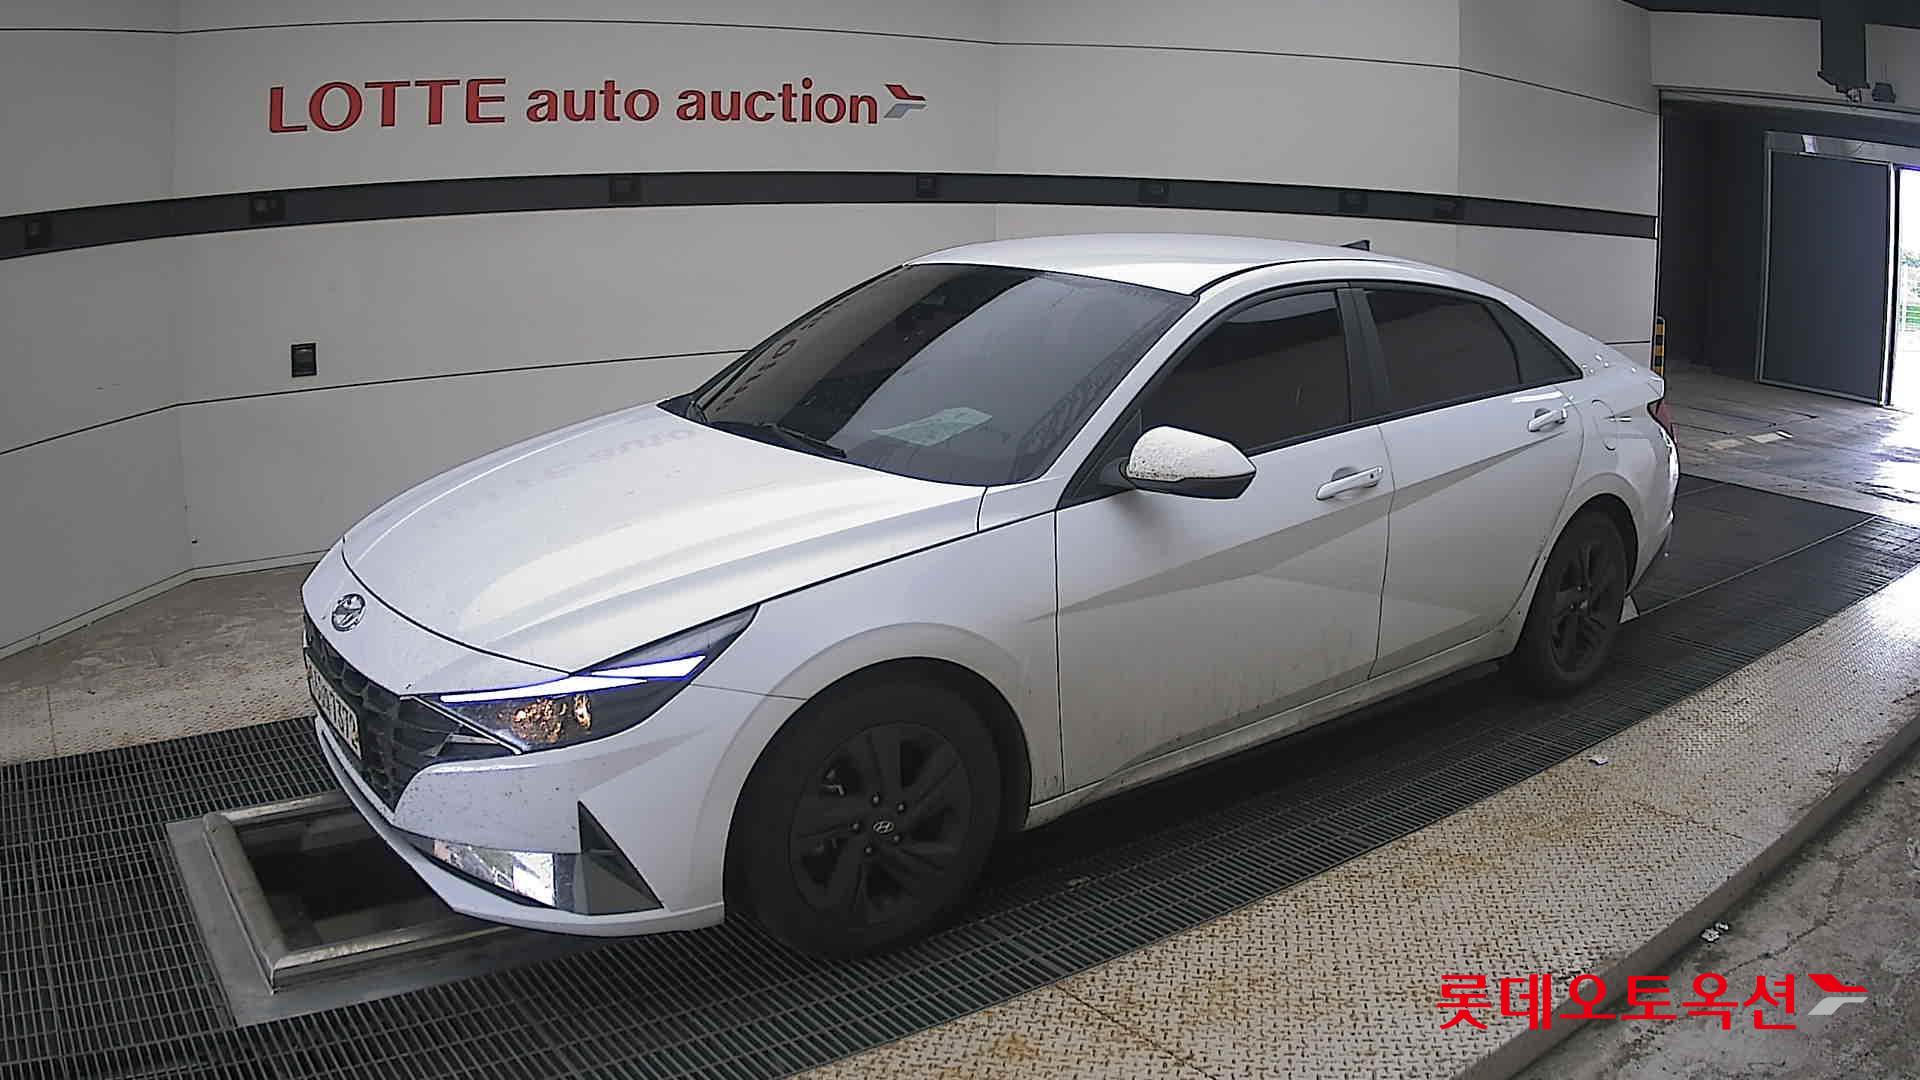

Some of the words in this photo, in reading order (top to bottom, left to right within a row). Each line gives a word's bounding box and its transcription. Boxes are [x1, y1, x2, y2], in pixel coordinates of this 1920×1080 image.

[269, 79, 505, 133] LOTTE
[526, 80, 660, 123] auto
[676, 78, 879, 124] auction
